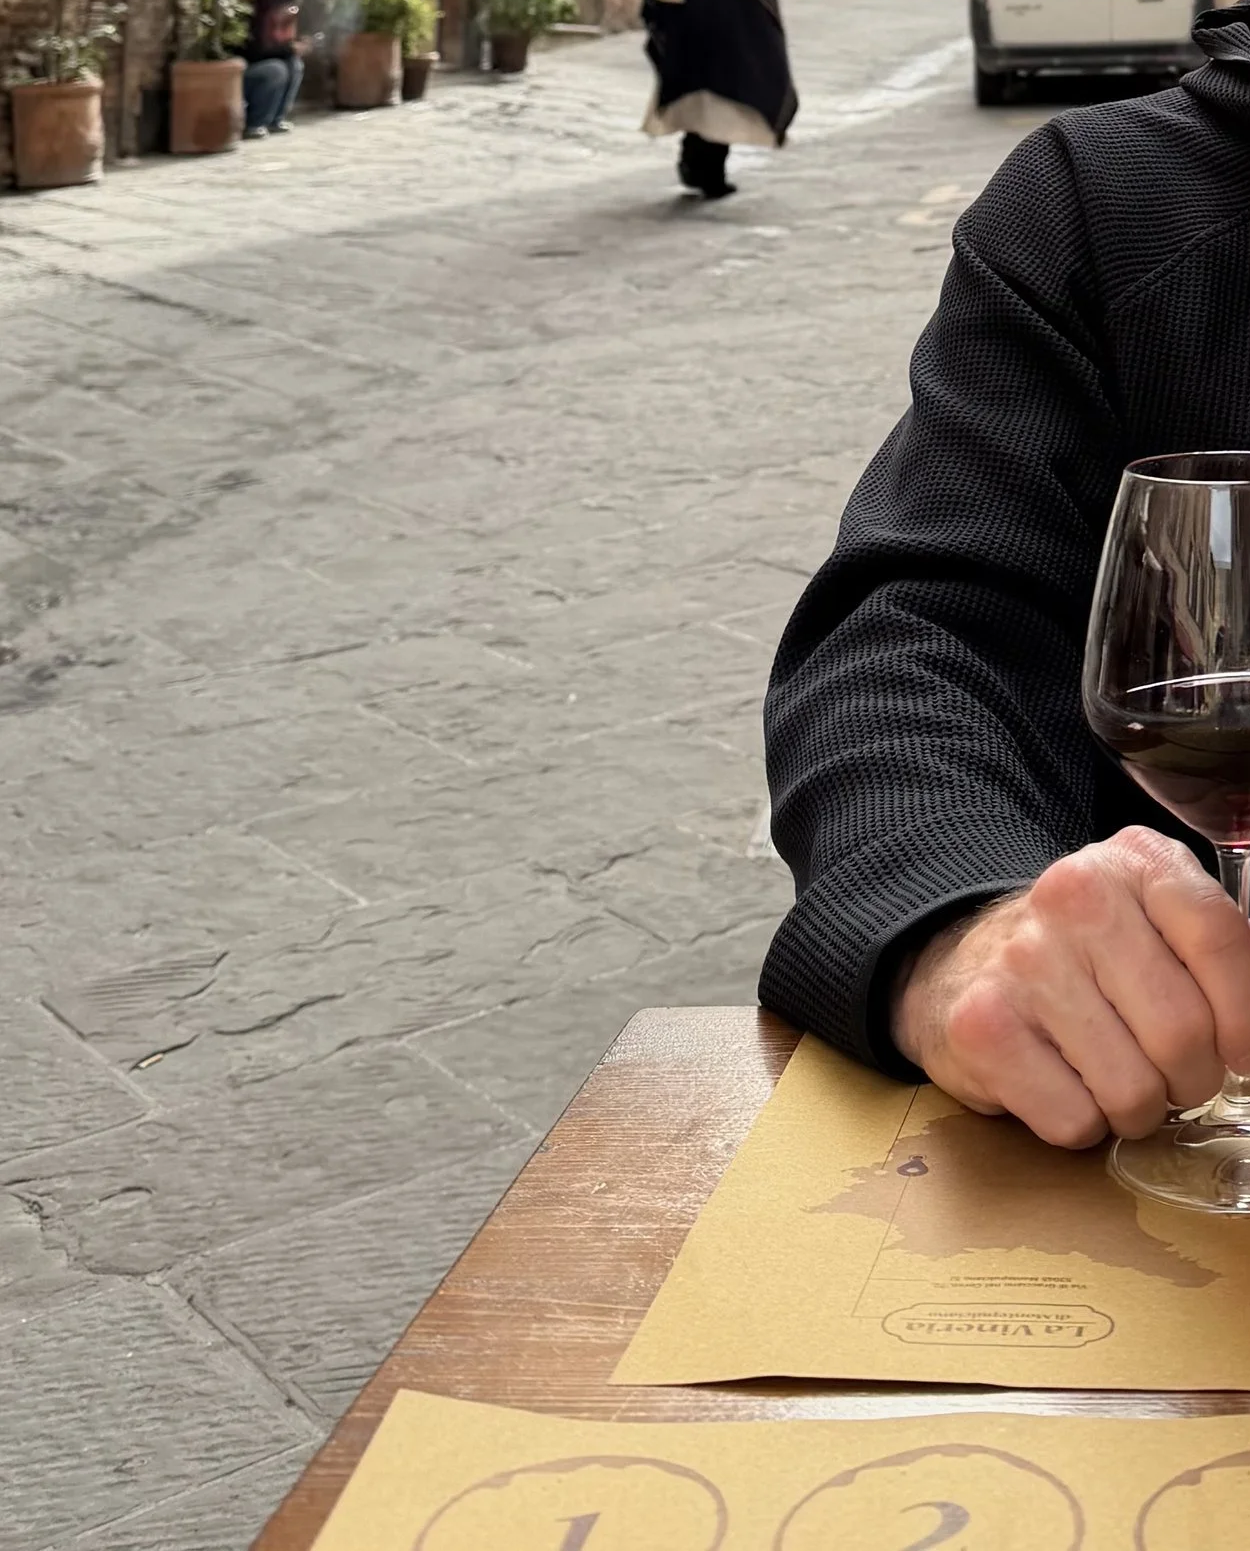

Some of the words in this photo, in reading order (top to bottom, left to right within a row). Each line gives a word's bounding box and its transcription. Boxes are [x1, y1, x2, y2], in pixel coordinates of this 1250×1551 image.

[928, 1312, 1052, 1321] Montepulciano
[905, 1322, 1033, 1337] Vineria
[1044, 1324, 1088, 1337] La
